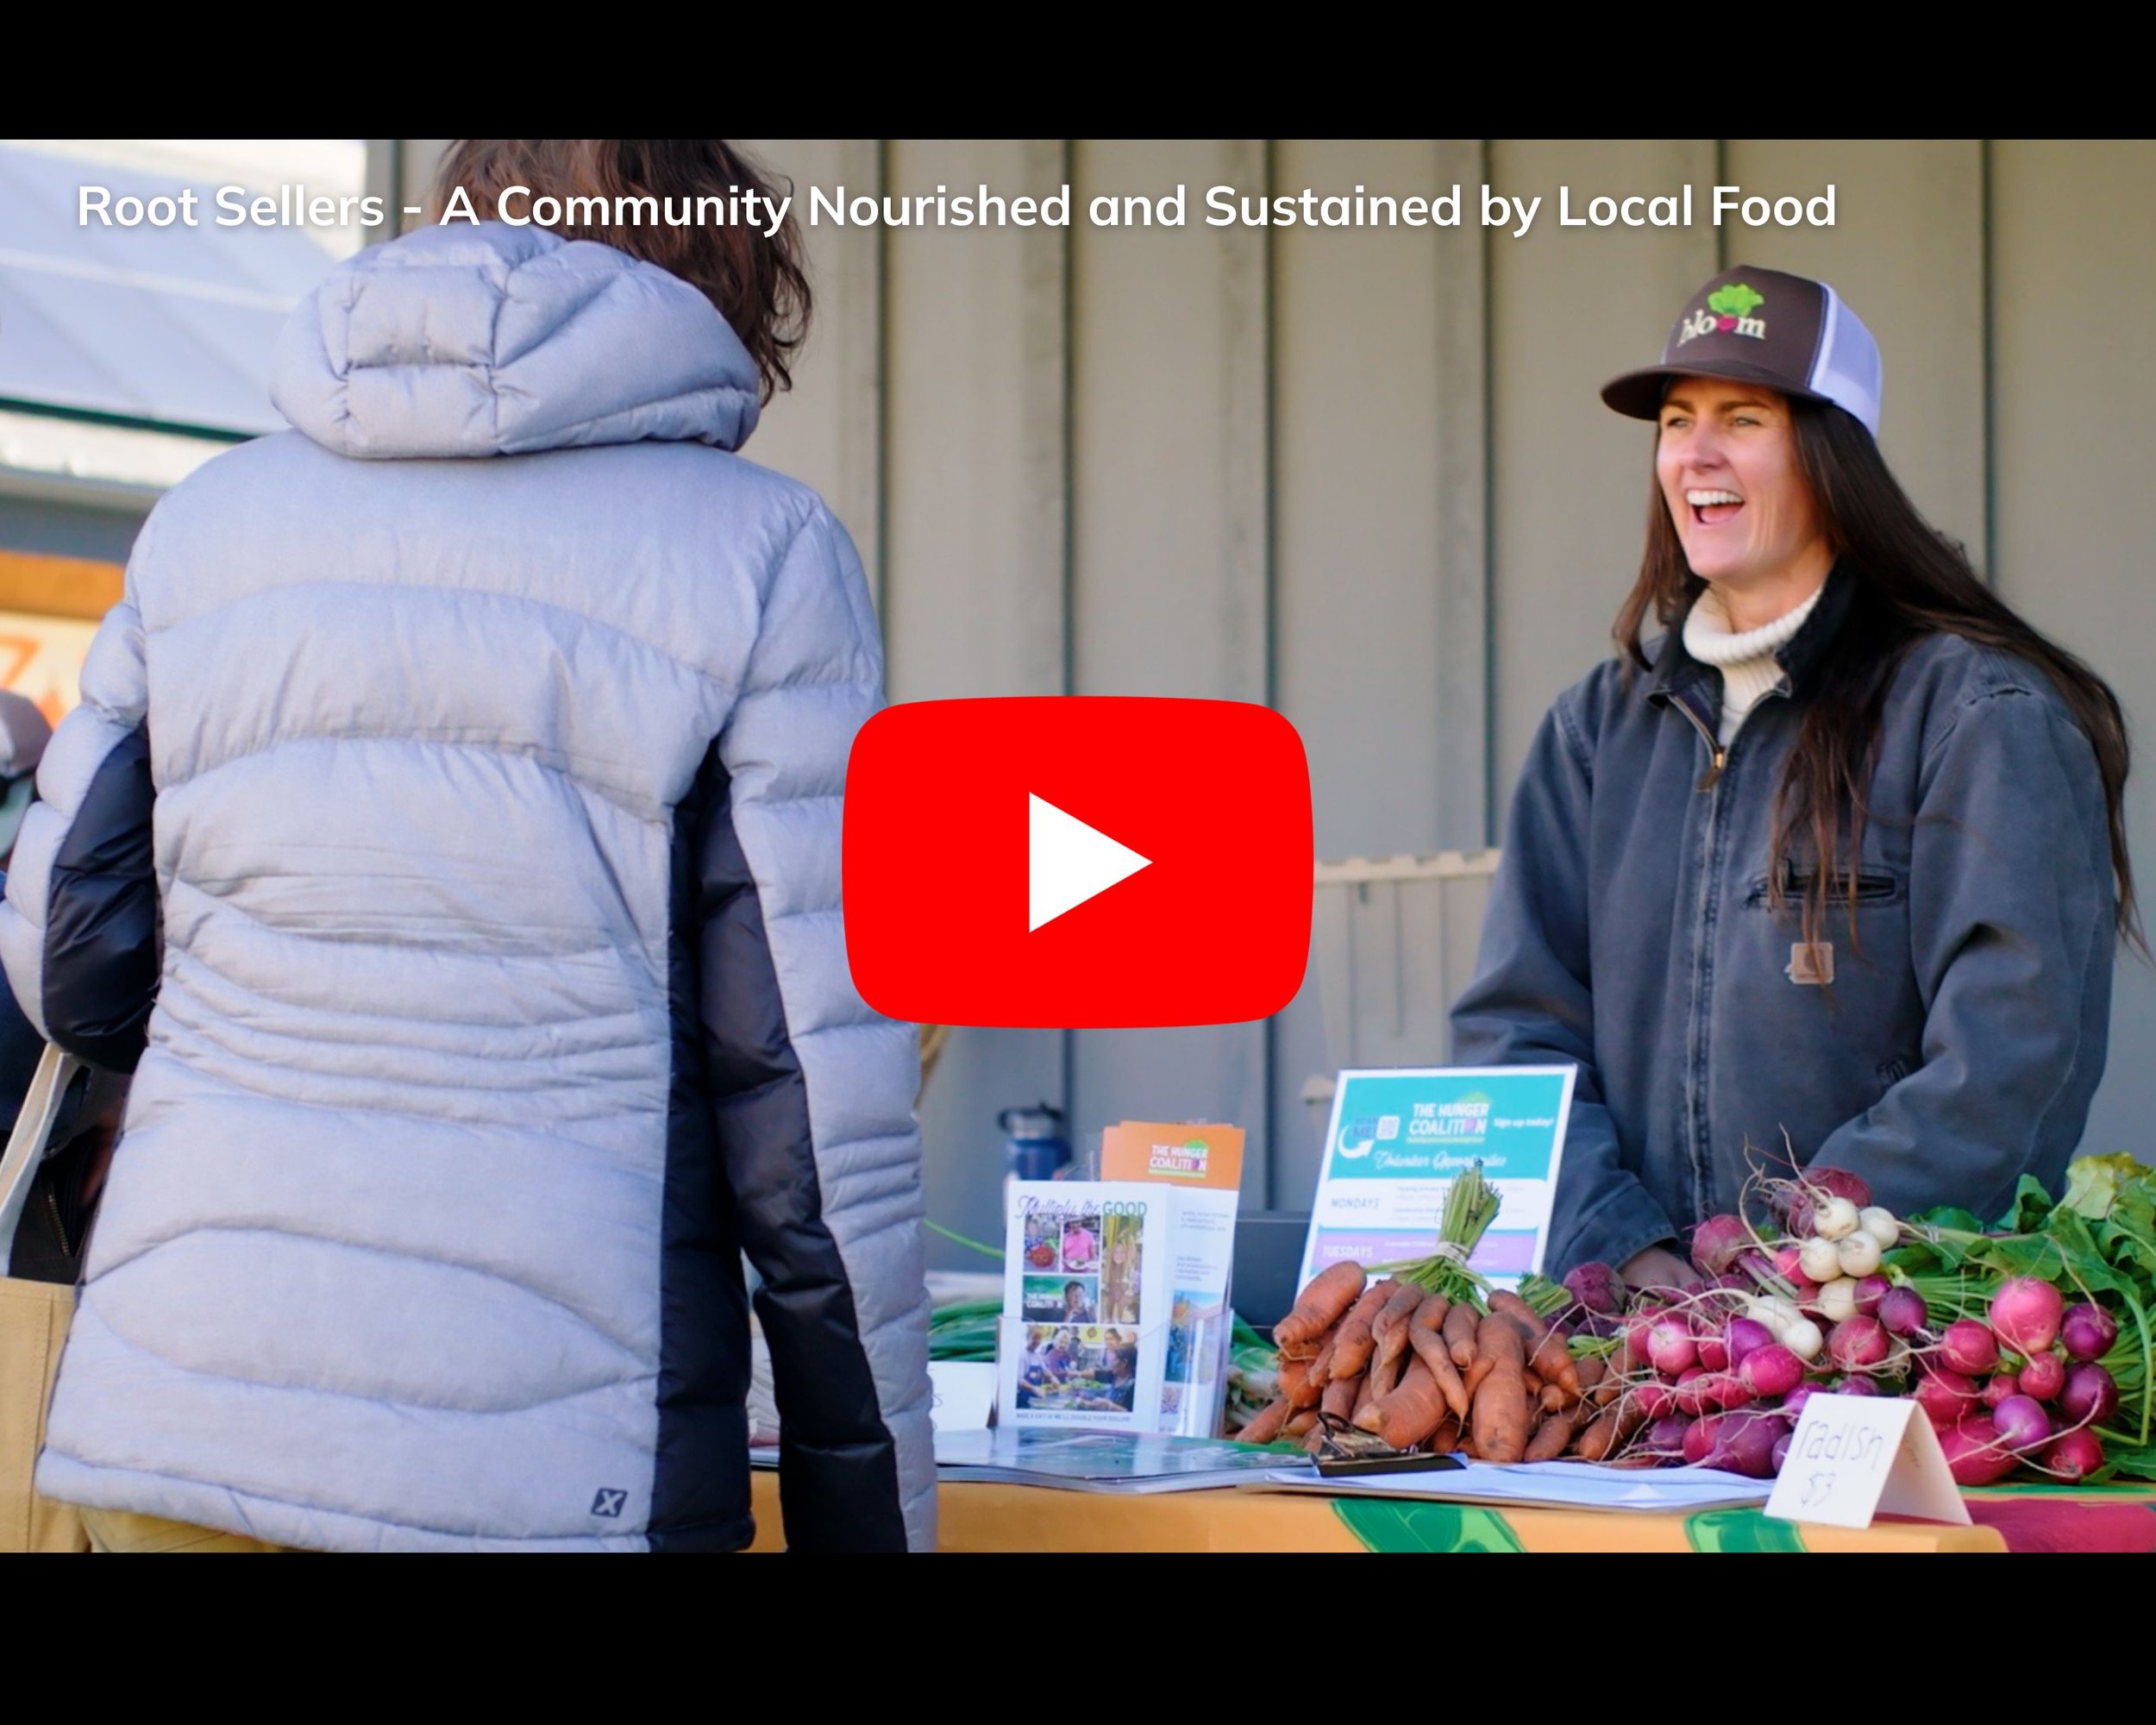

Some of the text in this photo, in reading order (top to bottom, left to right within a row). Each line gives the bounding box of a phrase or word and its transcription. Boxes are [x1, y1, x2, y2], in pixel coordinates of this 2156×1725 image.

[1413, 1103, 1489, 1118] THE HUNGER
[1409, 1118, 1487, 1136] COALITION
[1152, 1145, 1207, 1158] THE HUNGER
[1150, 1157, 1206, 1171] COALITION
[1103, 1201, 1148, 1216] GOOD
[1331, 1198, 1380, 1208] MONDAYS
[1323, 1245, 1373, 1258] TUESDAYS
